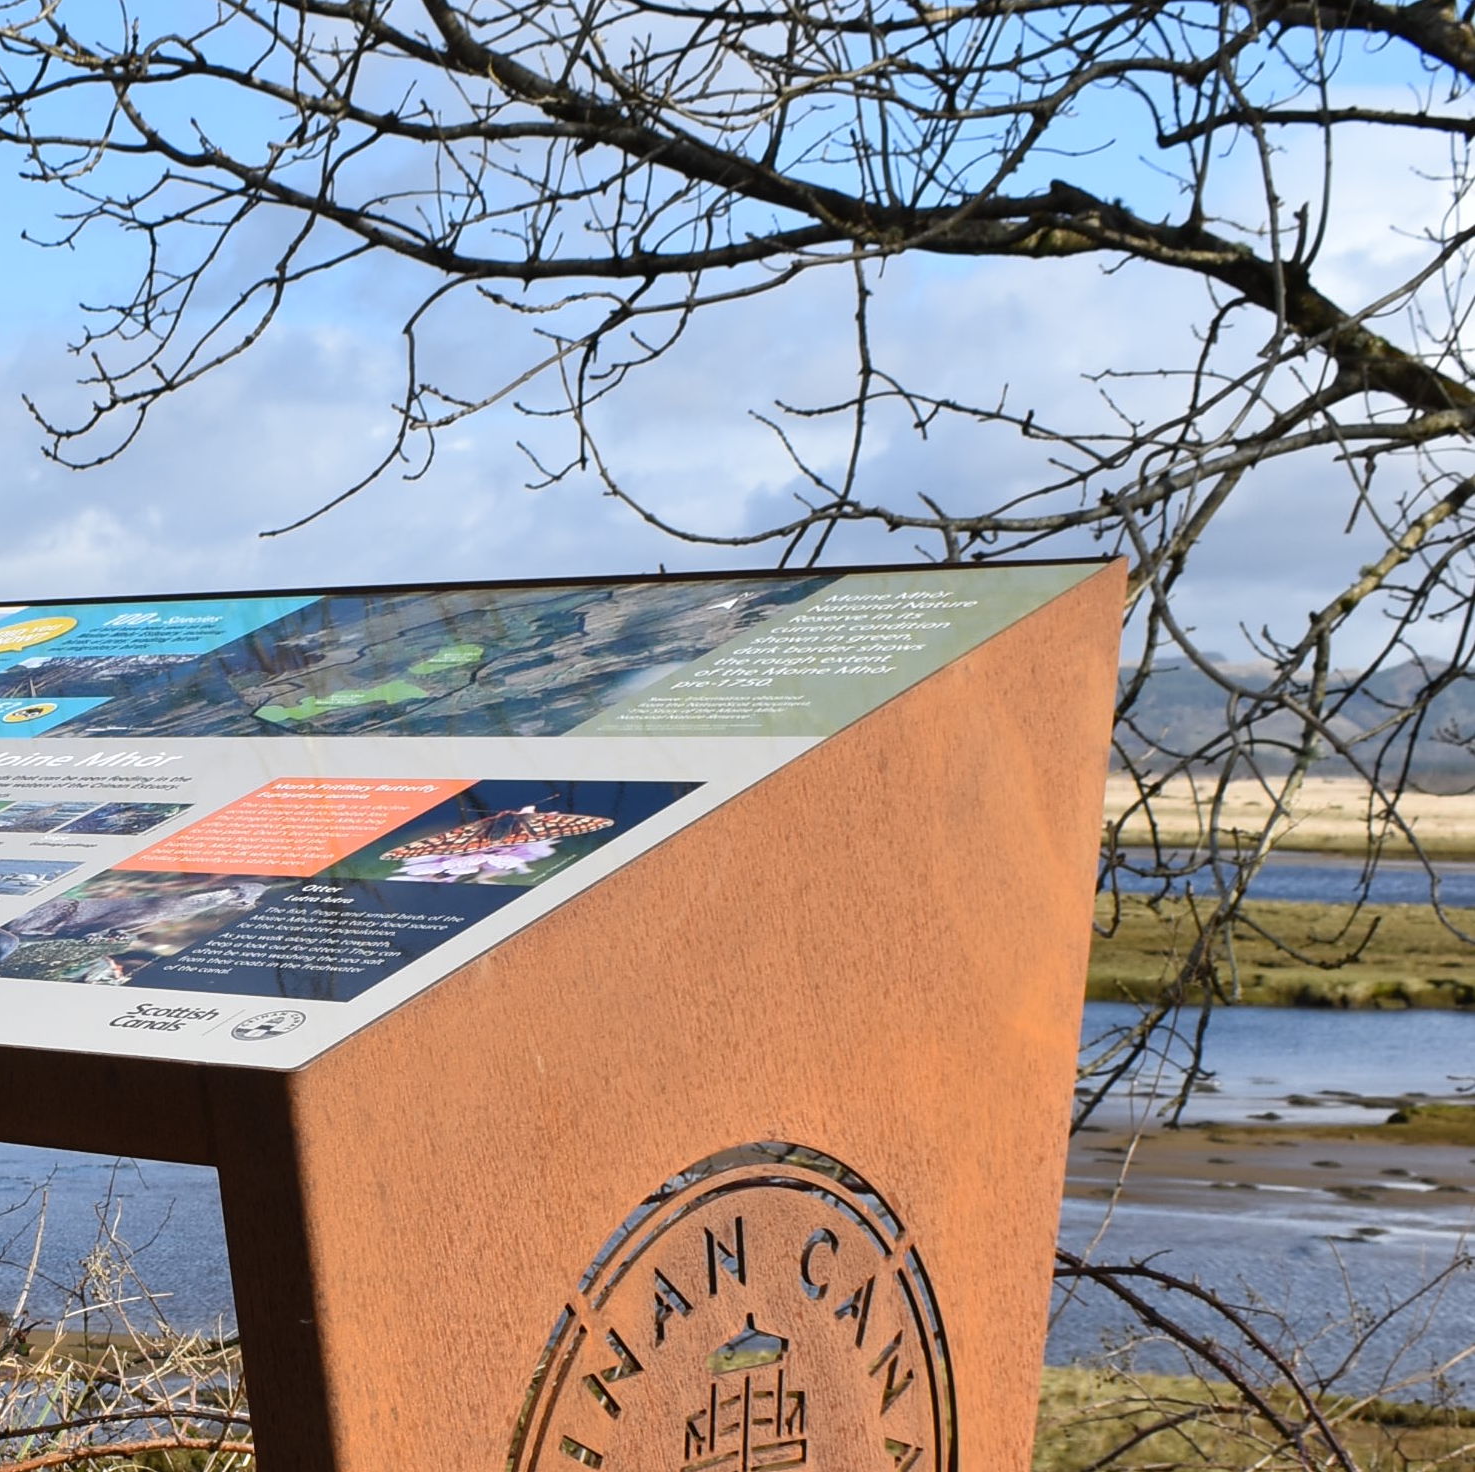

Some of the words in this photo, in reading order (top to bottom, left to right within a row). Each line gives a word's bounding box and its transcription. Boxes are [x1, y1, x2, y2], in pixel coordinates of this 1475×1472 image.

[826, 594, 891, 602] Moine
[895, 591, 953, 599] Mhòr
[807, 602, 902, 612] National
[902, 601, 978, 609] Nature
[771, 624, 846, 633] current
[849, 622, 950, 630] condition
[751, 636, 819, 644] shown
[734, 646, 780, 654] dark
[783, 645, 854, 653] border
[857, 644, 925, 652] shows
[753, 656, 816, 666] rough
[821, 655, 892, 663] extent
[694, 668, 723, 676] of
[722, 668, 758, 676] the
[834, 666, 896, 674] Mhòr
[671, 678, 772, 689] pre-1750.
[74, 752, 182, 767] Mhòr
[285, 936, 318, 944] along
[349, 948, 378, 956] They
[268, 954, 316, 962] washing
[302, 964, 364, 972] freshwater
[127, 1004, 219, 1020] Scottish
[110, 1016, 186, 1031] Canals
